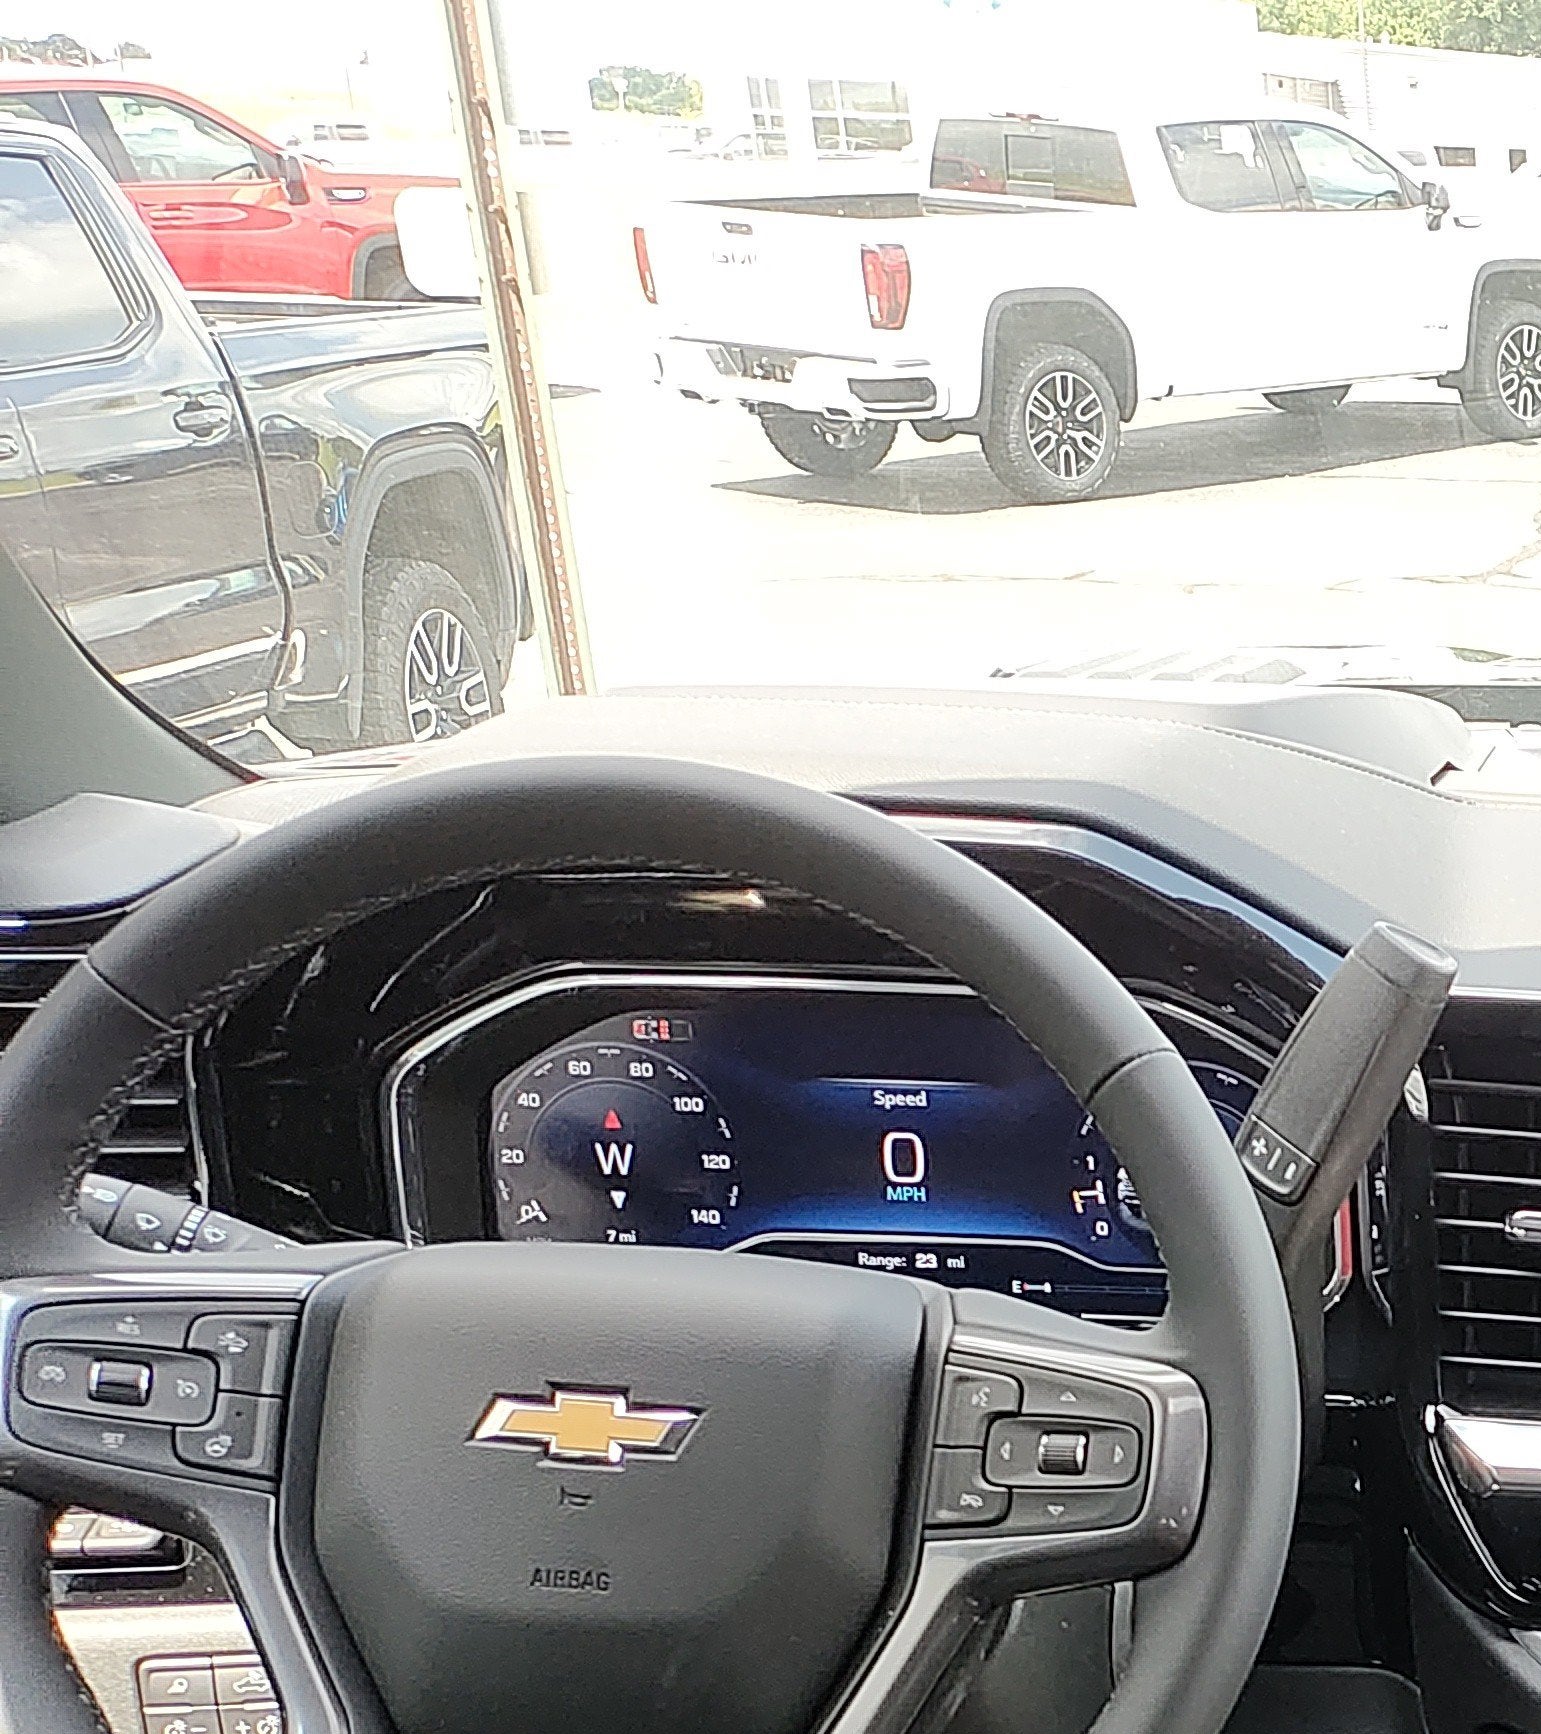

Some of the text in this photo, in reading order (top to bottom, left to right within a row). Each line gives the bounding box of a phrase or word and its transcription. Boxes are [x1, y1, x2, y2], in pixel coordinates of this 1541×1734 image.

[568, 1061, 591, 1076] 60
[629, 1062, 654, 1077] 80
[517, 1093, 540, 1108] 40
[673, 1097, 704, 1112] 100
[873, 1090, 928, 1109] Speed
[501, 1149, 524, 1164] 20
[594, 1142, 633, 1176] W
[701, 1154, 731, 1169] 120
[883, 1131, 925, 1183] 0
[886, 1186, 926, 1202] MPH
[690, 1209, 720, 1224] 140
[606, 1229, 637, 1242] 7 mi
[858, 1252, 966, 1270] Range: 23 mi
[1011, 1280, 1022, 1294] E
[530, 1568, 612, 1591] AIRBAG
